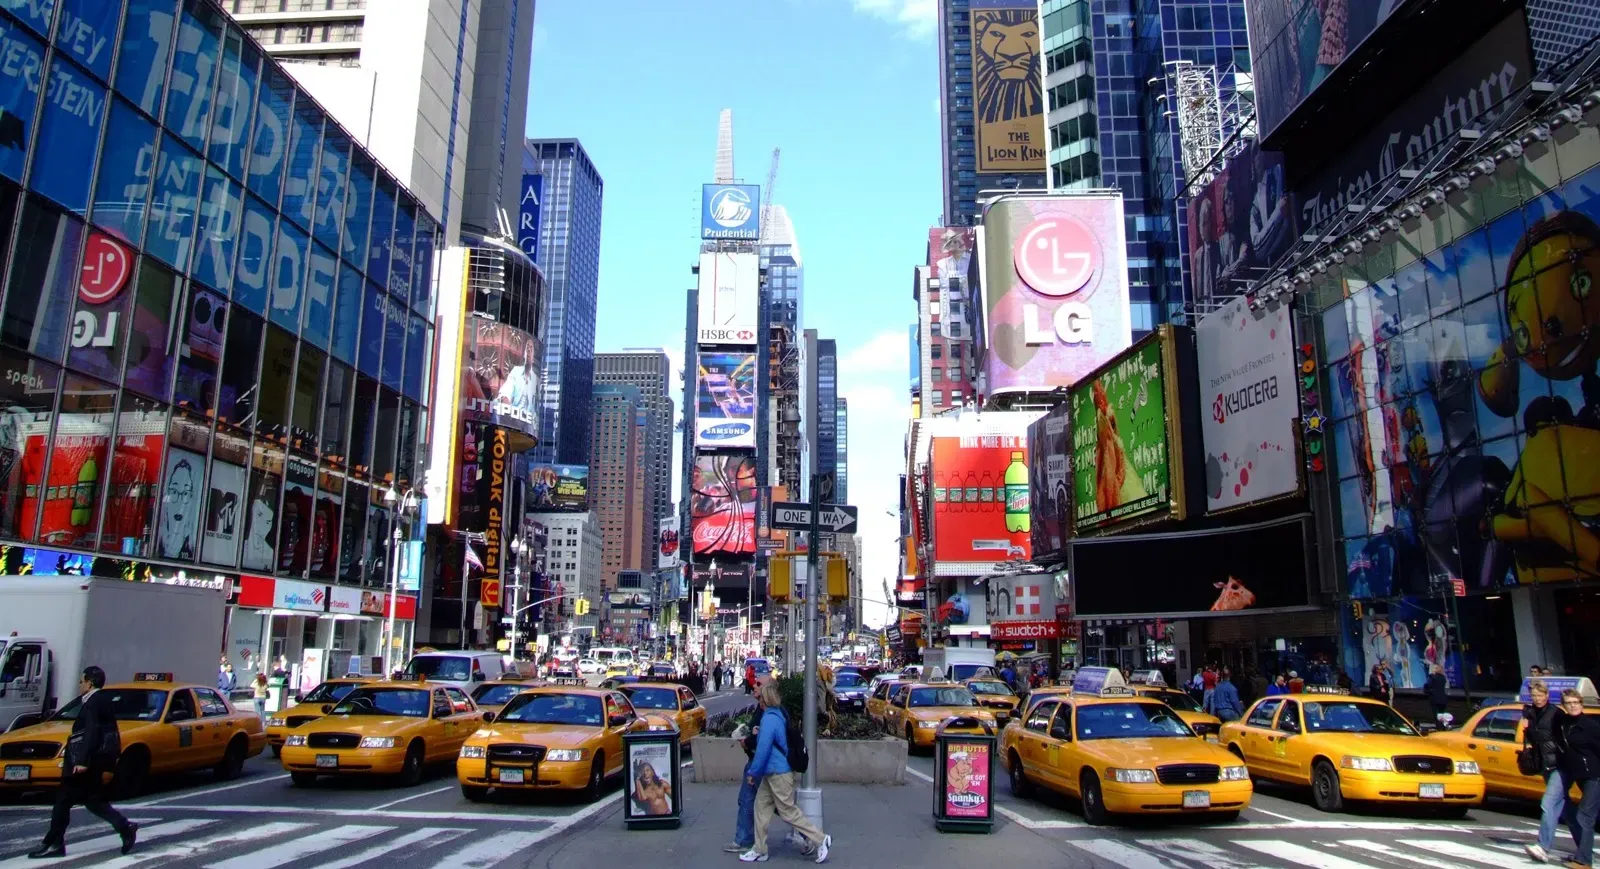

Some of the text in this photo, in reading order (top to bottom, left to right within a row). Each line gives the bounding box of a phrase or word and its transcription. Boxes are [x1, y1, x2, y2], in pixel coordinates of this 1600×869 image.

[137, 10, 358, 252] FIDDLER
[1008, 131, 1030, 142] THE
[987, 145, 1017, 162] LION
[704, 228, 756, 239] Prudential
[191, 181, 337, 330] ROOF
[1023, 302, 1093, 345] LG
[701, 330, 735, 340] HSBC
[6, 368, 44, 389] speak
[706, 427, 745, 435] SAMSUNG
[981, 436, 999, 448] MORE
[486, 428, 505, 574] KODAK digital
[206, 487, 239, 534] MTV
[783, 510, 847, 525] ONE WAY
[1005, 624, 1047, 637] swatch
[948, 745, 987, 753] BIG BUTTS
[947, 793, 986, 804] Spanky's
